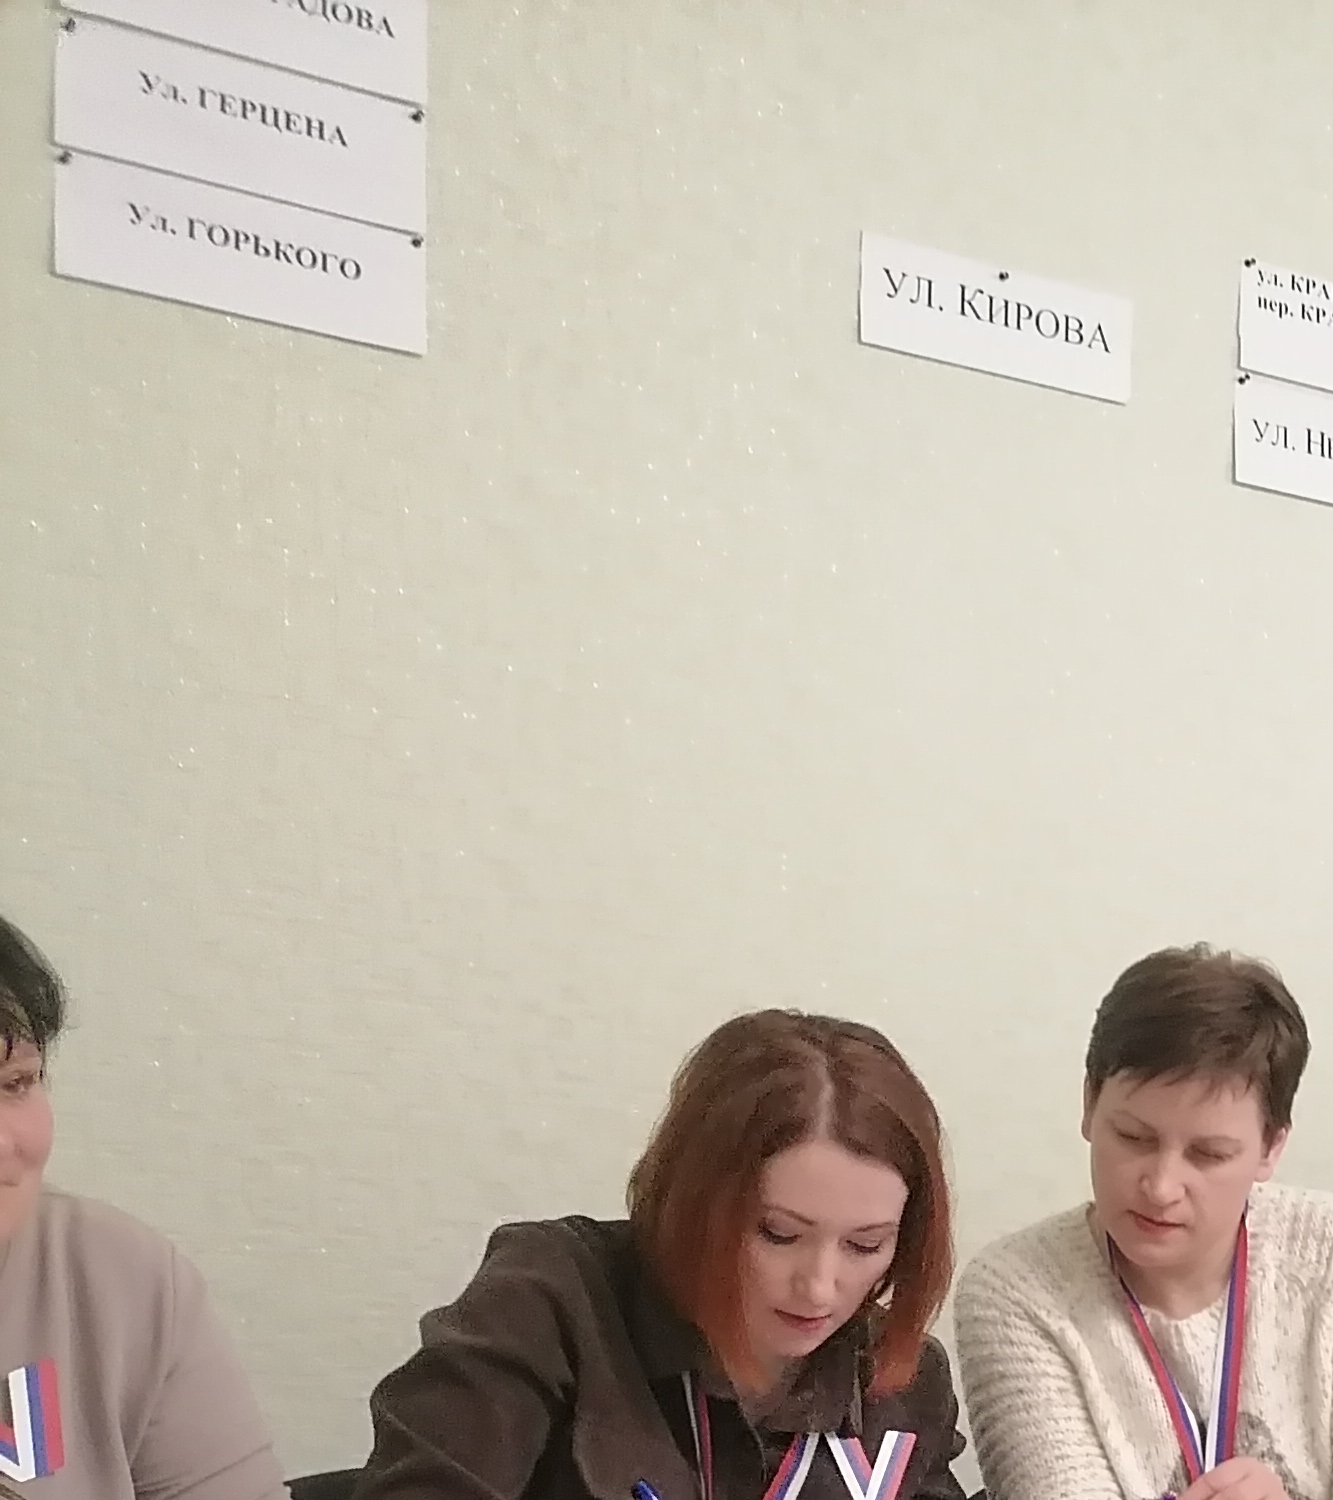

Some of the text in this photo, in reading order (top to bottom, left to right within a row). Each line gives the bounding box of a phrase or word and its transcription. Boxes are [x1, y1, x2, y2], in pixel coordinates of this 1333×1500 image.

[138, 70, 349, 148] Ул. ГЕРЦЕНА
[128, 202, 362, 282] Ул. ГОРЬКОГО
[1257, 269, 1284, 288] ул.
[882, 268, 1111, 354] УЛ. КИРОВА
[1257, 296, 1294, 319] пер.
[1252, 418, 1296, 451] УЛ.
